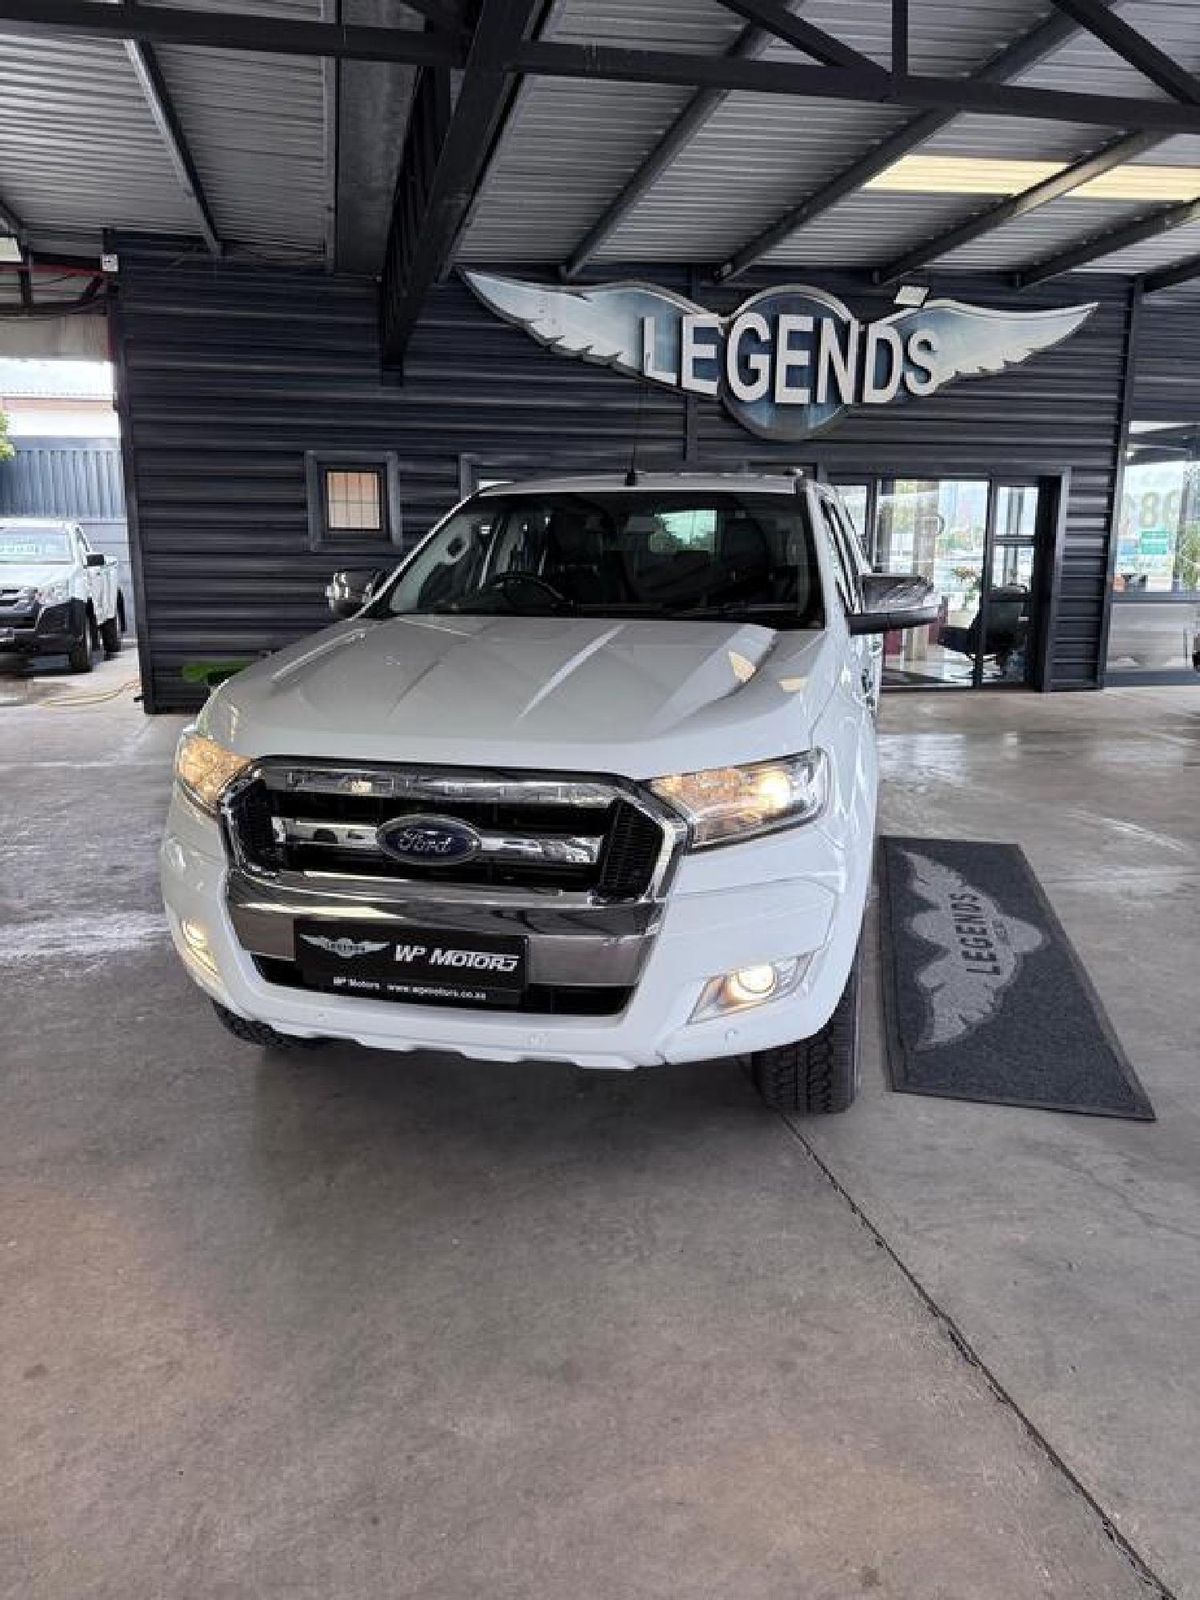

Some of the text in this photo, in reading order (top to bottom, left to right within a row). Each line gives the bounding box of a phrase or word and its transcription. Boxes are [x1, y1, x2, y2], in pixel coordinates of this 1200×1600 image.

[643, 312, 938, 404] LEGENDS
[399, 828, 452, 853] Ford
[395, 944, 427, 962] WP
[949, 892, 1001, 976] LEGENDS
